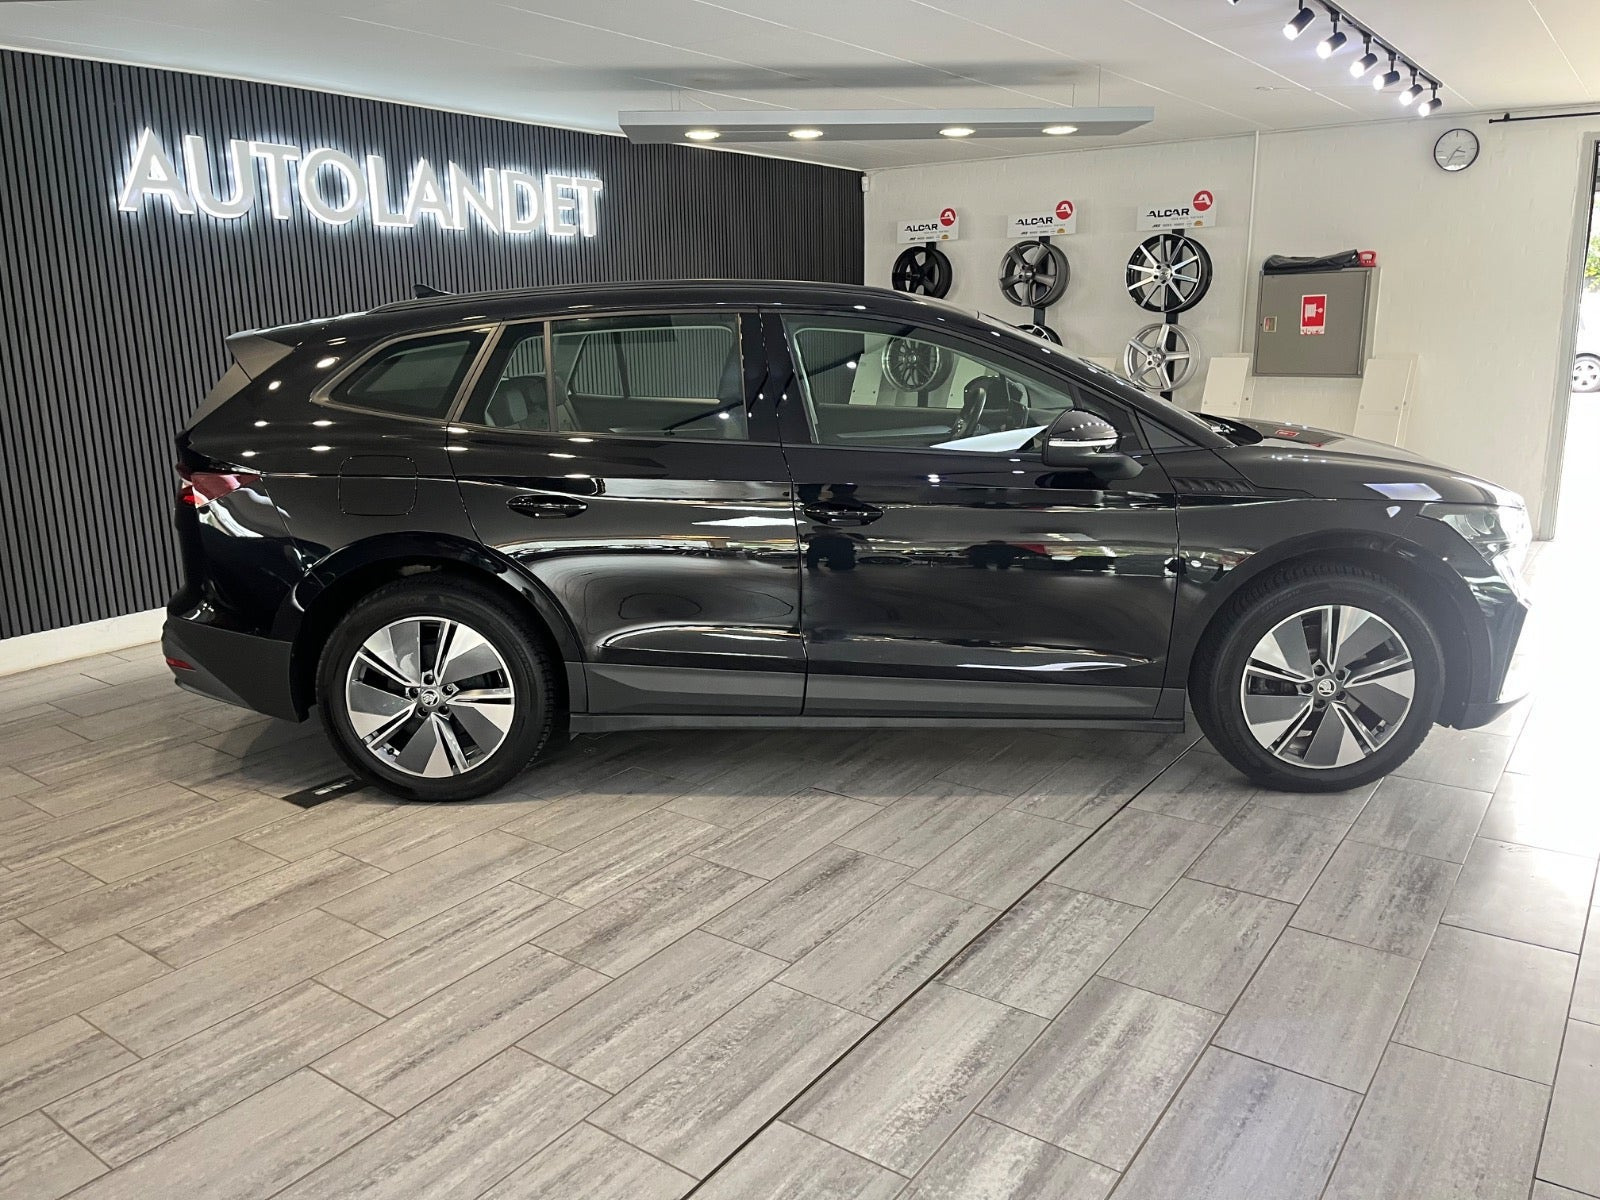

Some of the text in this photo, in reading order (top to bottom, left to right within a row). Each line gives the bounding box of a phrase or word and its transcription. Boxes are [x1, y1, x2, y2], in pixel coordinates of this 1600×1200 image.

[118, 126, 603, 238] AUTOLANDET
[1146, 208, 1190, 218] ALCAR
[1015, 216, 1053, 226] ALCAR
[904, 223, 938, 232] ALCAR
